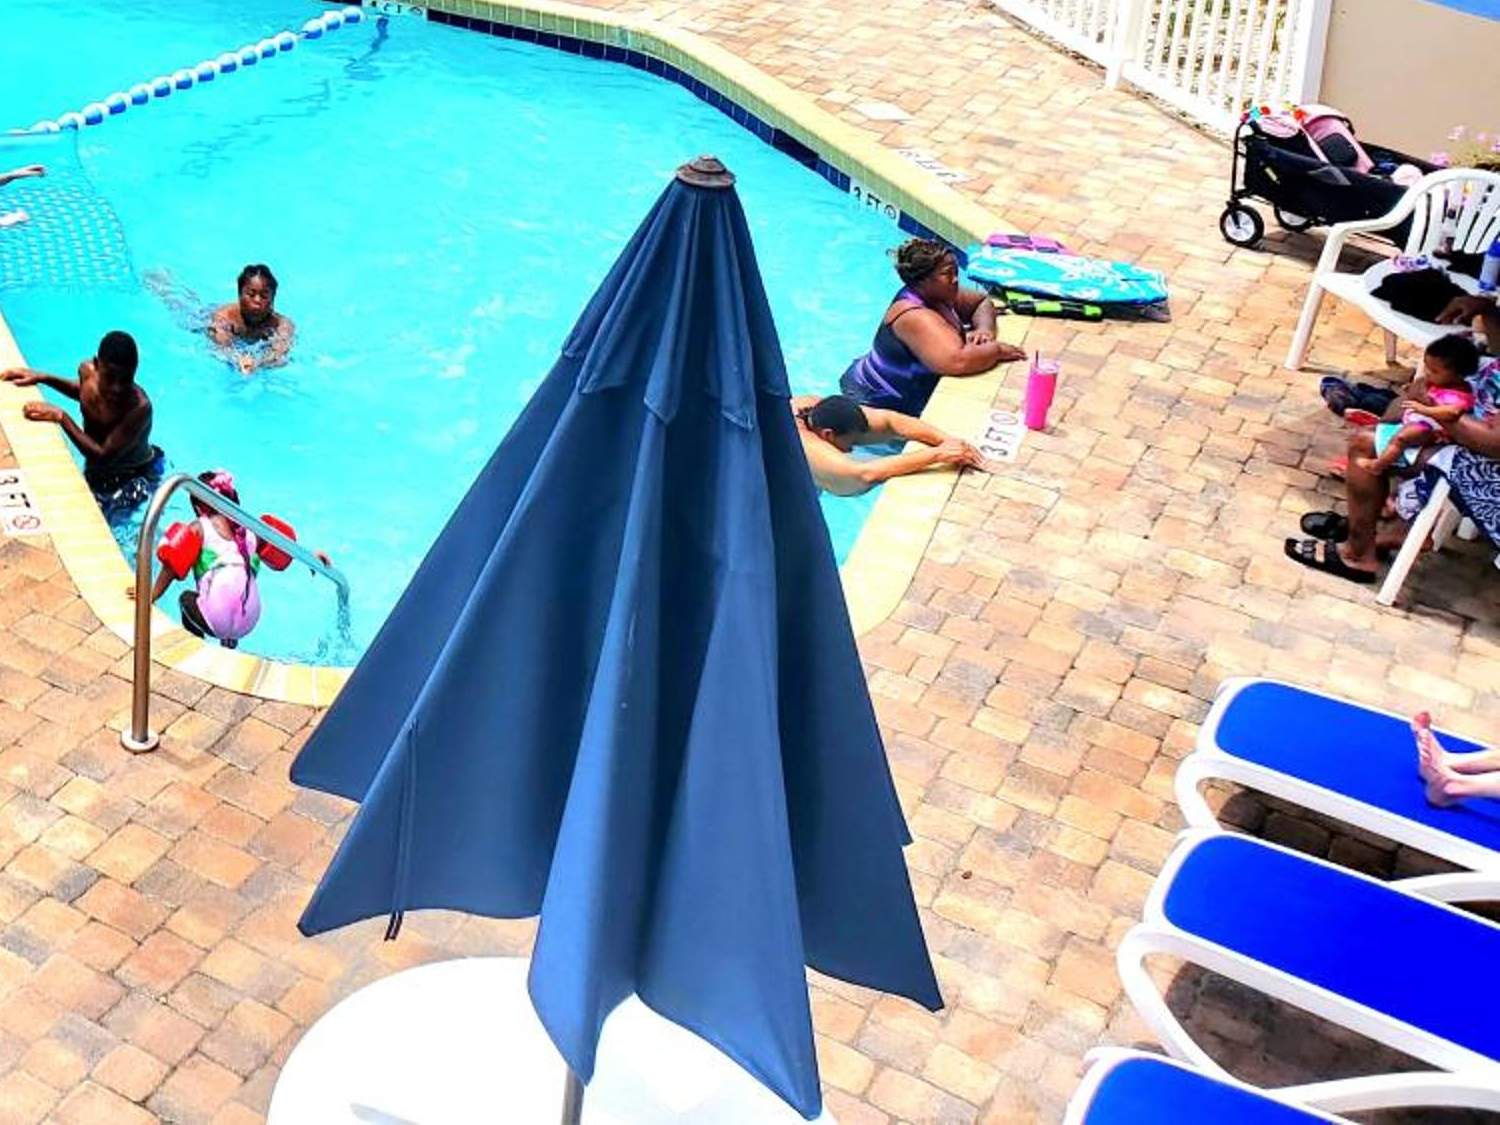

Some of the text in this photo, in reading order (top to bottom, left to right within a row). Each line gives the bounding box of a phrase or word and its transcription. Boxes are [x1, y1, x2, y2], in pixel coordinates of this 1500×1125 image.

[866, 192, 882, 212] FT
[979, 426, 1016, 457] 3 FT
